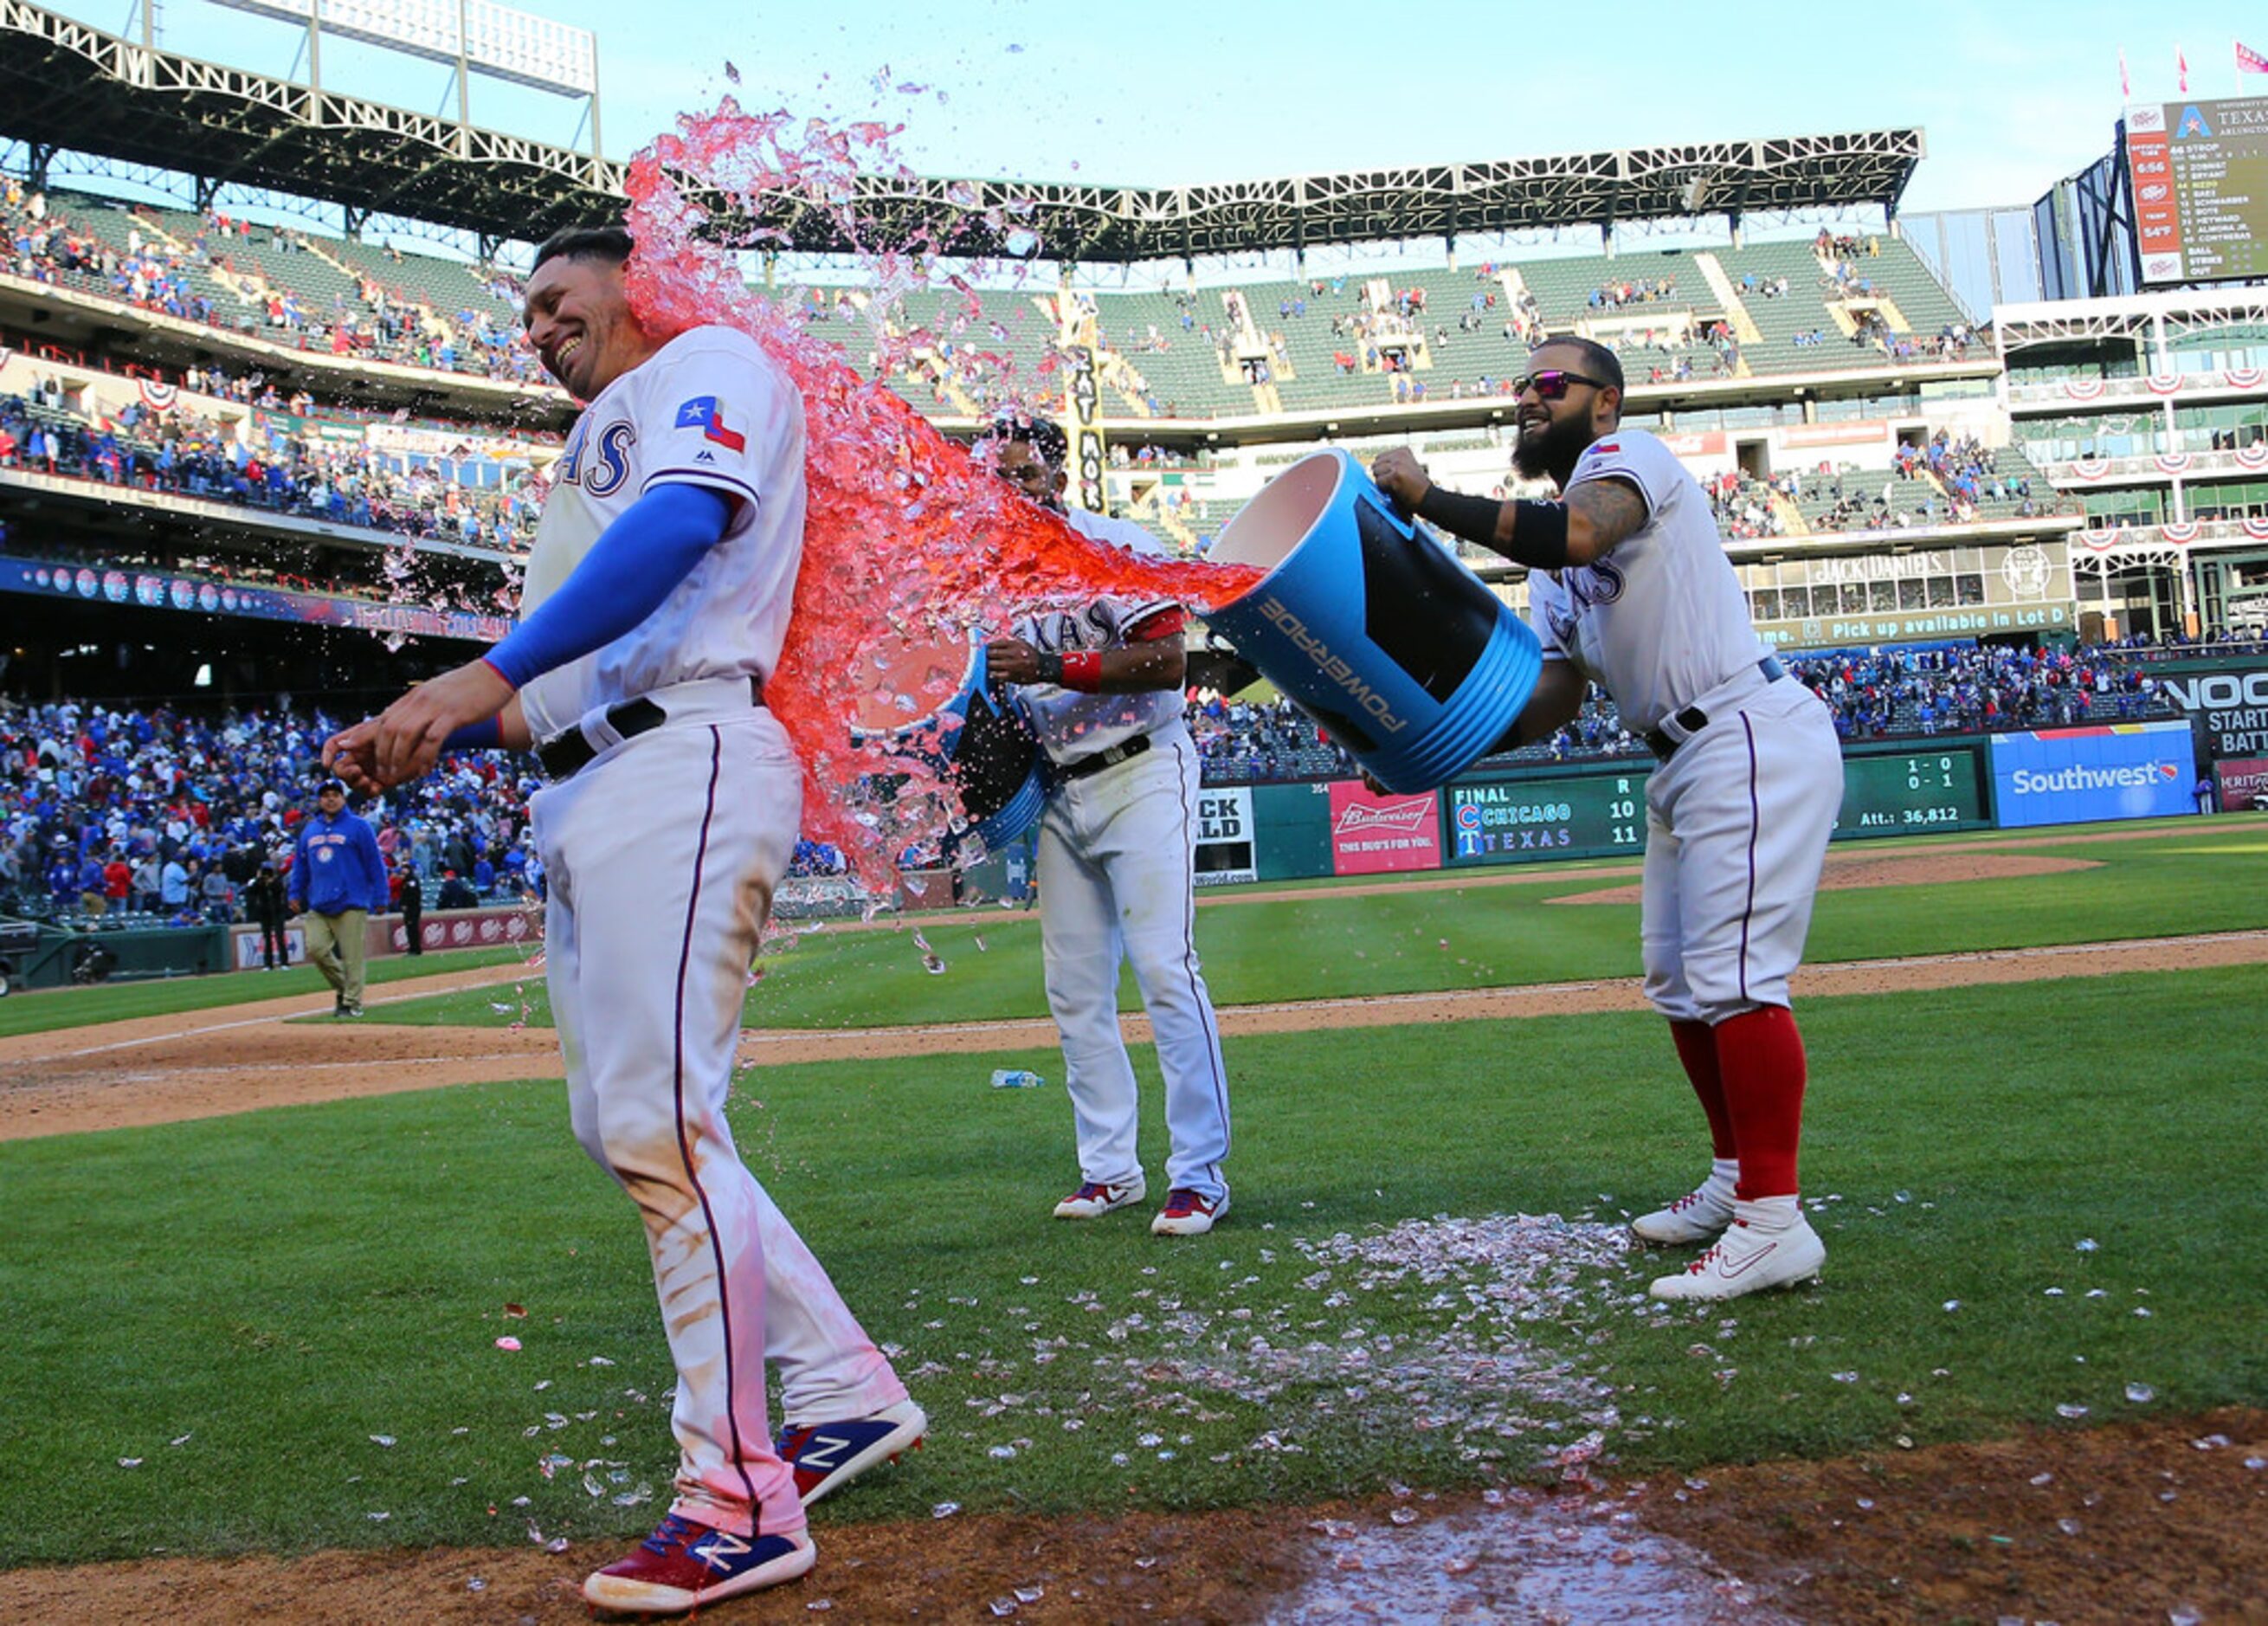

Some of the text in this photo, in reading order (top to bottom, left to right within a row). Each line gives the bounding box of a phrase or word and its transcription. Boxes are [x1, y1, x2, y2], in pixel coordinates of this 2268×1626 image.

[2217, 110, 2268, 126] TEXA
[1816, 557, 1863, 583] JACK
[1833, 623, 1871, 639] Pick
[1877, 621, 1897, 637] up
[1905, 614, 1986, 633] available
[2017, 610, 2046, 624] Lot
[2052, 607, 2064, 623] D
[1259, 595, 1408, 733] POWERADE
[1455, 778, 1630, 804] FINAL R
[2013, 762, 2158, 794] Southwest
[1343, 807, 1422, 825] Budweiser
[1481, 803, 1571, 826] CHICAGO
[1609, 800, 1635, 818] 10
[1903, 807, 1959, 825] 36,812
[1339, 842, 1360, 852] THIS
[1390, 838, 1410, 848] FOR
[1484, 829, 1572, 851] TEXAS
[1612, 825, 1638, 843] 11
